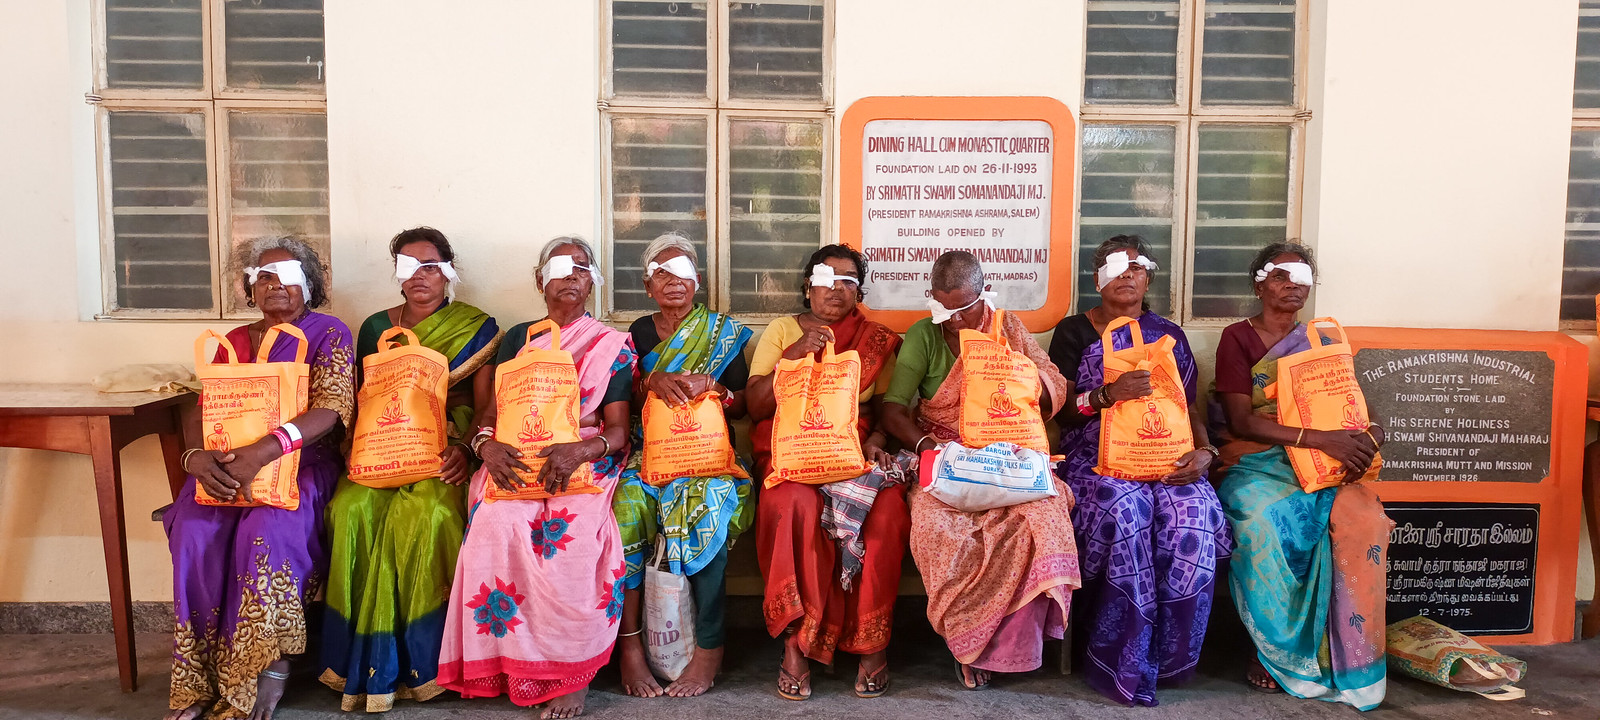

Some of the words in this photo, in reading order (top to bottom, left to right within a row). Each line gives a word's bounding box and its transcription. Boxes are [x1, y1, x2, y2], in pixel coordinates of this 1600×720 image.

[868, 137, 904, 153] DINING
[908, 137, 938, 153] HALL
[939, 137, 957, 153] CUM
[958, 137, 1008, 153] MONASTIC
[1009, 137, 1050, 155] QUARTER
[875, 165, 934, 174] FOUNDATION
[938, 165, 960, 174] LAID
[963, 165, 977, 174] ON
[982, 163, 1037, 174] 26-11-1993
[866, 186, 876, 200] BY
[878, 185, 921, 200] SRIMATH
[923, 185, 956, 200] SWAMI
[958, 185, 1026, 200] SOMANANDAJI
[868, 208, 916, 220] (PRESIDENT
[918, 209, 973, 219] RAMAKRISHNA
[897, 228, 940, 237] BUILDING
[947, 228, 986, 237] OPENED
[992, 228, 1005, 238] BY
[864, 247, 905, 262] SRIMATH
[907, 247, 941, 262] SWAMI
[1034, 248, 1048, 263] MJ
[870, 271, 918, 283] (PRESIDENT
[1362, 365, 1386, 383] THE
[1387, 352, 1469, 373] RAMAKRISHNA
[1473, 353, 1536, 385] INDUSTRIAL
[1404, 374, 1464, 385] STUDENTS
[1470, 374, 1500, 385] HOME
[1396, 393, 1449, 403] FOUNDATION
[1453, 394, 1480, 403] STONE
[1485, 394, 1506, 403] LAID
[1390, 417, 1406, 428] HIS
[1410, 418, 1453, 428] SERENE
[1457, 418, 1510, 429] HOLINESS
[1394, 432, 1425, 442] SWAMI
[1428, 432, 1498, 444] SHIVANANDAJI
[1501, 433, 1549, 445] MAHARAJ
[1417, 447, 1465, 456] PRESIDENT
[1468, 447, 1481, 456] OF
[1381, 459, 1443, 470] RAMAKRISHNA
[1446, 461, 1472, 470] MUTT
[1474, 461, 1493, 470] AND
[1495, 461, 1532, 471] MISSION
[1412, 473, 1457, 482] NOVEMBER
[1459, 473, 1478, 482] 1926
[1425, 521, 1443, 548] ஸ்ரீ
[1444, 526, 1489, 547] சாரதா
[1489, 522, 1534, 545] இல்லம்
[1393, 557, 1423, 572] சுவாமி
[1386, 592, 1428, 602] வர்களால்
